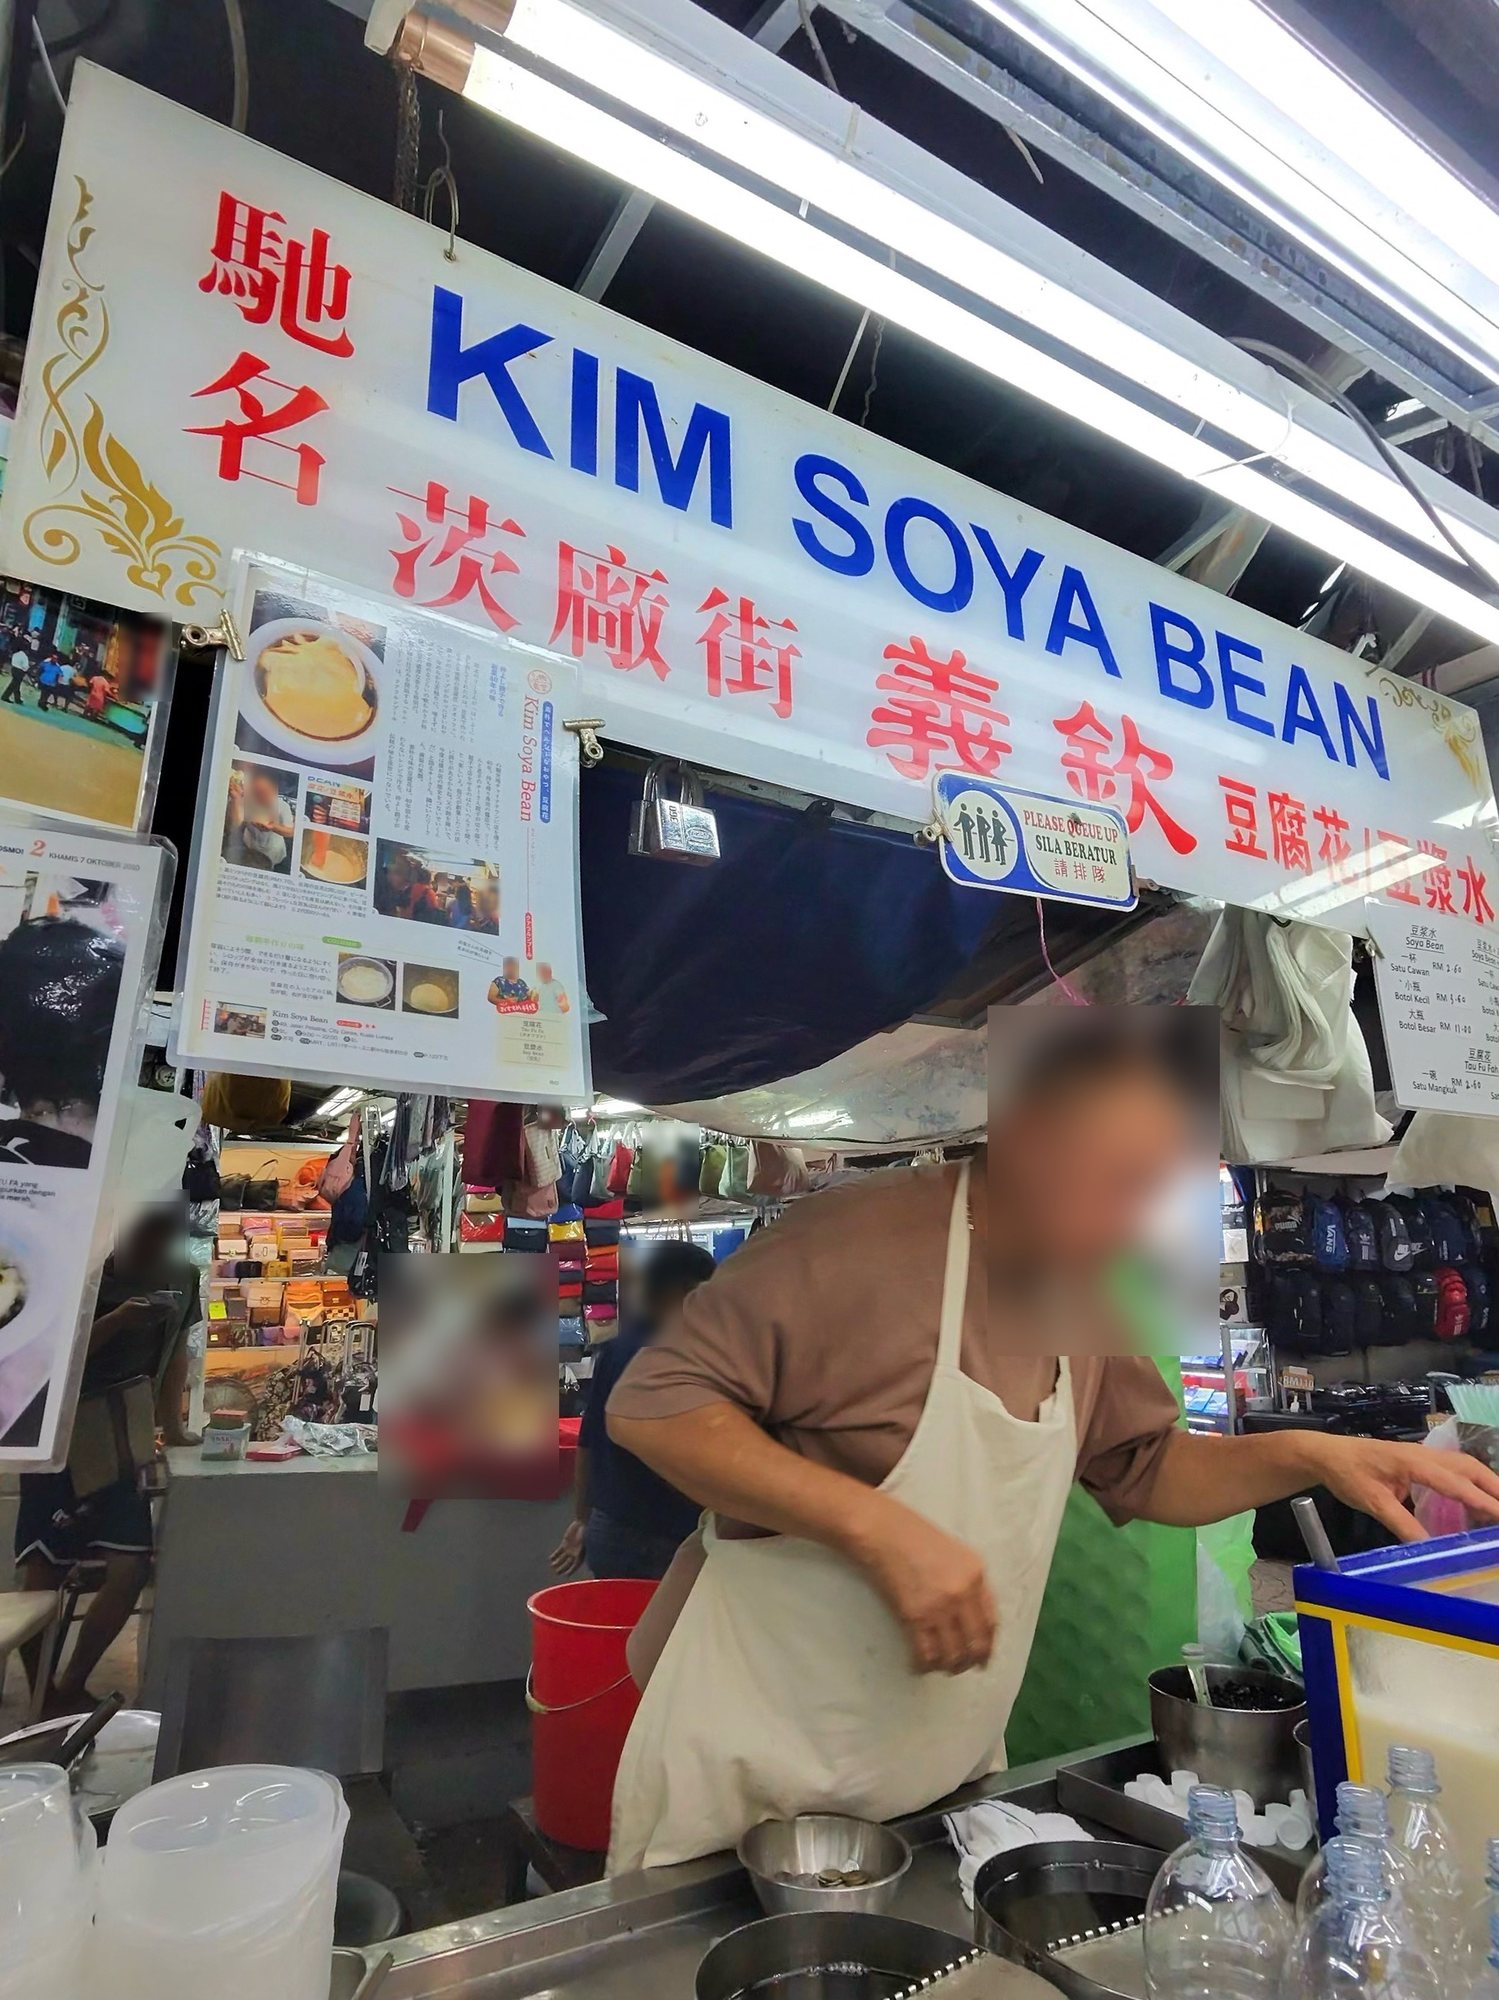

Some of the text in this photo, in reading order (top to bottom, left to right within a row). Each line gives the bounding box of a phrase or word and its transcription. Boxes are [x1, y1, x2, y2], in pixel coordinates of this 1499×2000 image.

[180, 190, 355, 506] 馳名
[427, 284, 1391, 781] KIM SOYA BEAN
[385, 480, 804, 718] 茨廠街
[517, 694, 539, 822] Kim Soya Bean
[1023, 809, 1118, 844] PLEASE QUEUE UP
[30, 839, 47, 858] 2
[49, 852, 79, 863] KHAMIS
[86, 858, 121, 869] OKTOBER
[1035, 834, 1118, 866] SILA BERATUR
[1053, 857, 1106, 884] 請排隊
[1405, 936, 1445, 951] Soya Bean
[1390, 963, 1406, 973] Satu
[1407, 966, 1431, 977] Cawan
[1432, 961, 1444, 971] RM
[1394, 992, 1413, 1002] Botol
[1414, 994, 1430, 1005] Kecil
[1436, 992, 1447, 1002] RM
[272, 1010, 329, 1024] Kim Soya Bean
[1398, 1020, 1417, 1031] Botol
[1417, 1023, 1437, 1033] Besar
[1439, 1021, 1452, 1031] RM
[1464, 1060, 1499, 1073] Tau Fu Fah
[1412, 1080, 1427, 1091] Satu
[1428, 1083, 1458, 1095] Mangkuk
[1451, 1077, 1463, 1087] RM
[1325, 1224, 1337, 1254] VANS
